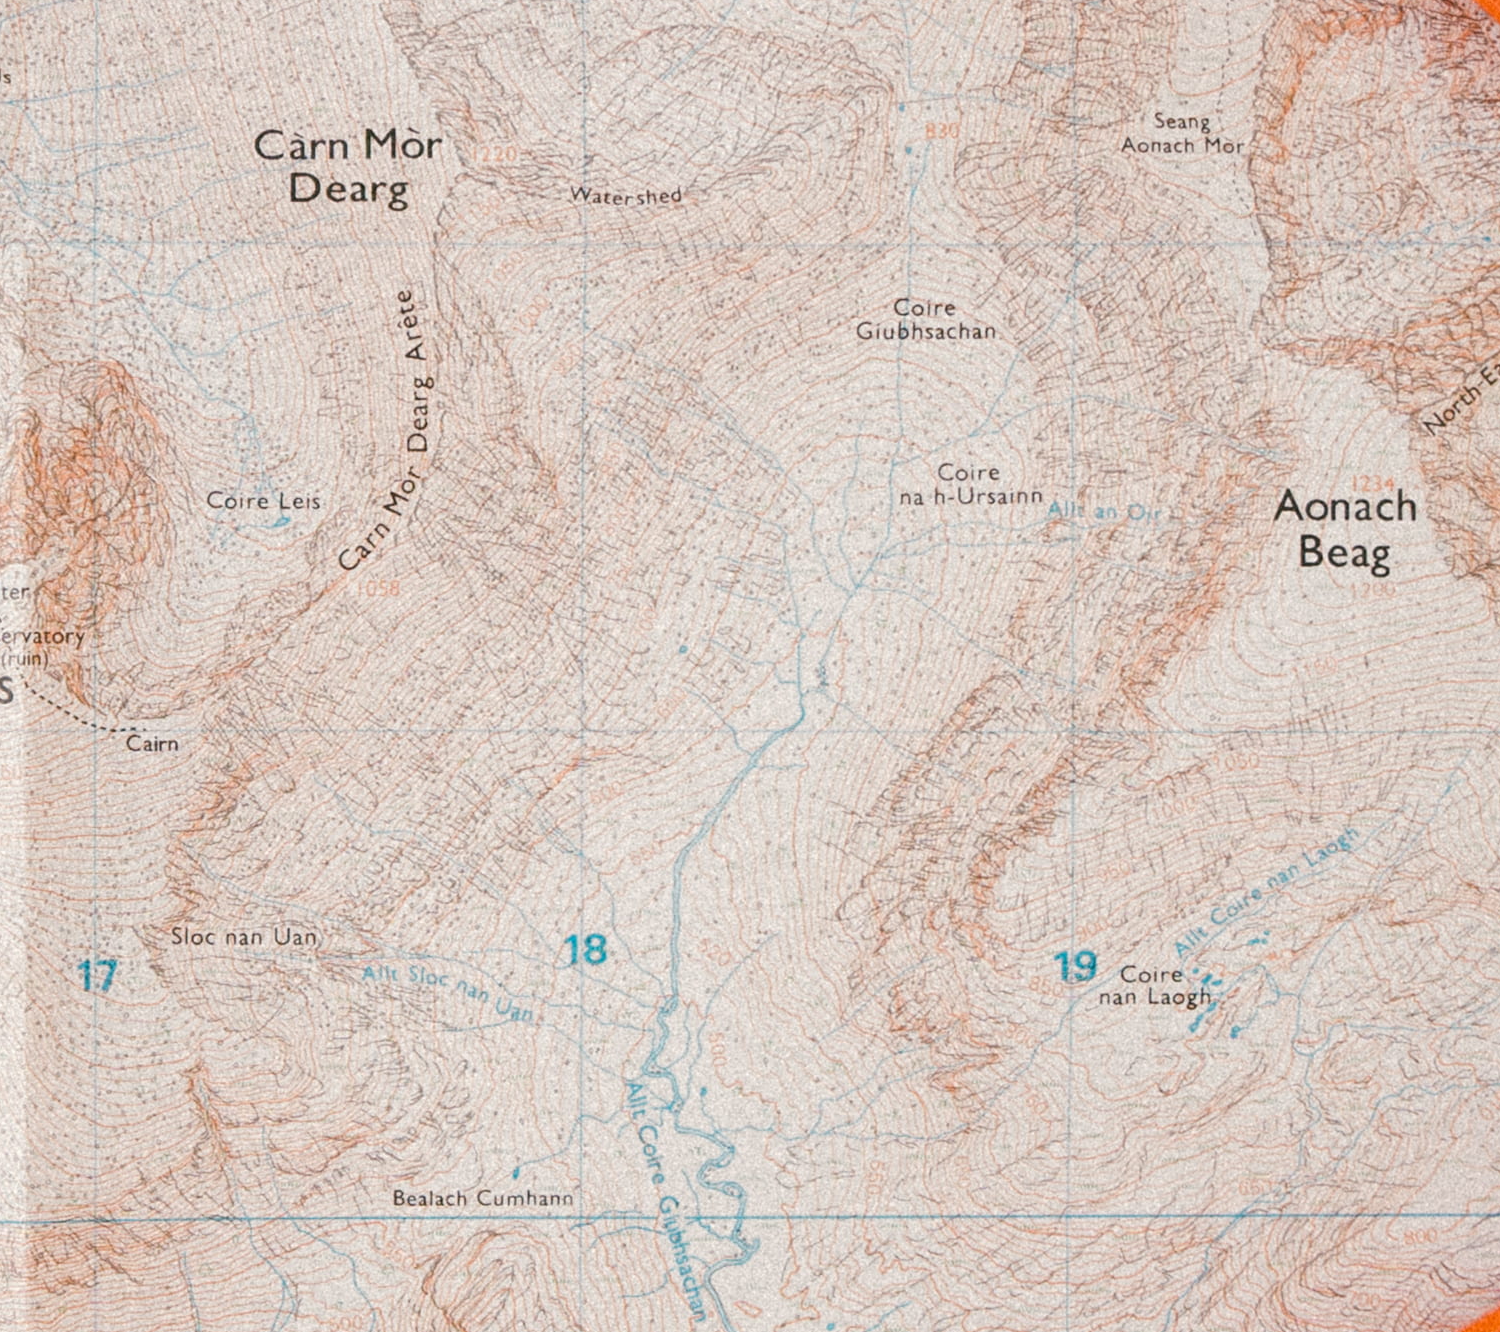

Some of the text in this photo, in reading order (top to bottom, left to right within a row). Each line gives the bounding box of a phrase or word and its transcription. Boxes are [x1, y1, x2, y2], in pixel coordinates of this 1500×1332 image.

[254, 128, 444, 162] Càrn Mòr
[288, 173, 411, 212] Dearg
[571, 186, 683, 206] Watershed
[1272, 489, 1419, 523] Aonach
[1297, 534, 1393, 576] Beag
[563, 934, 608, 965] 18
[77, 961, 119, 992] 17
[1054, 950, 1099, 983] 19
